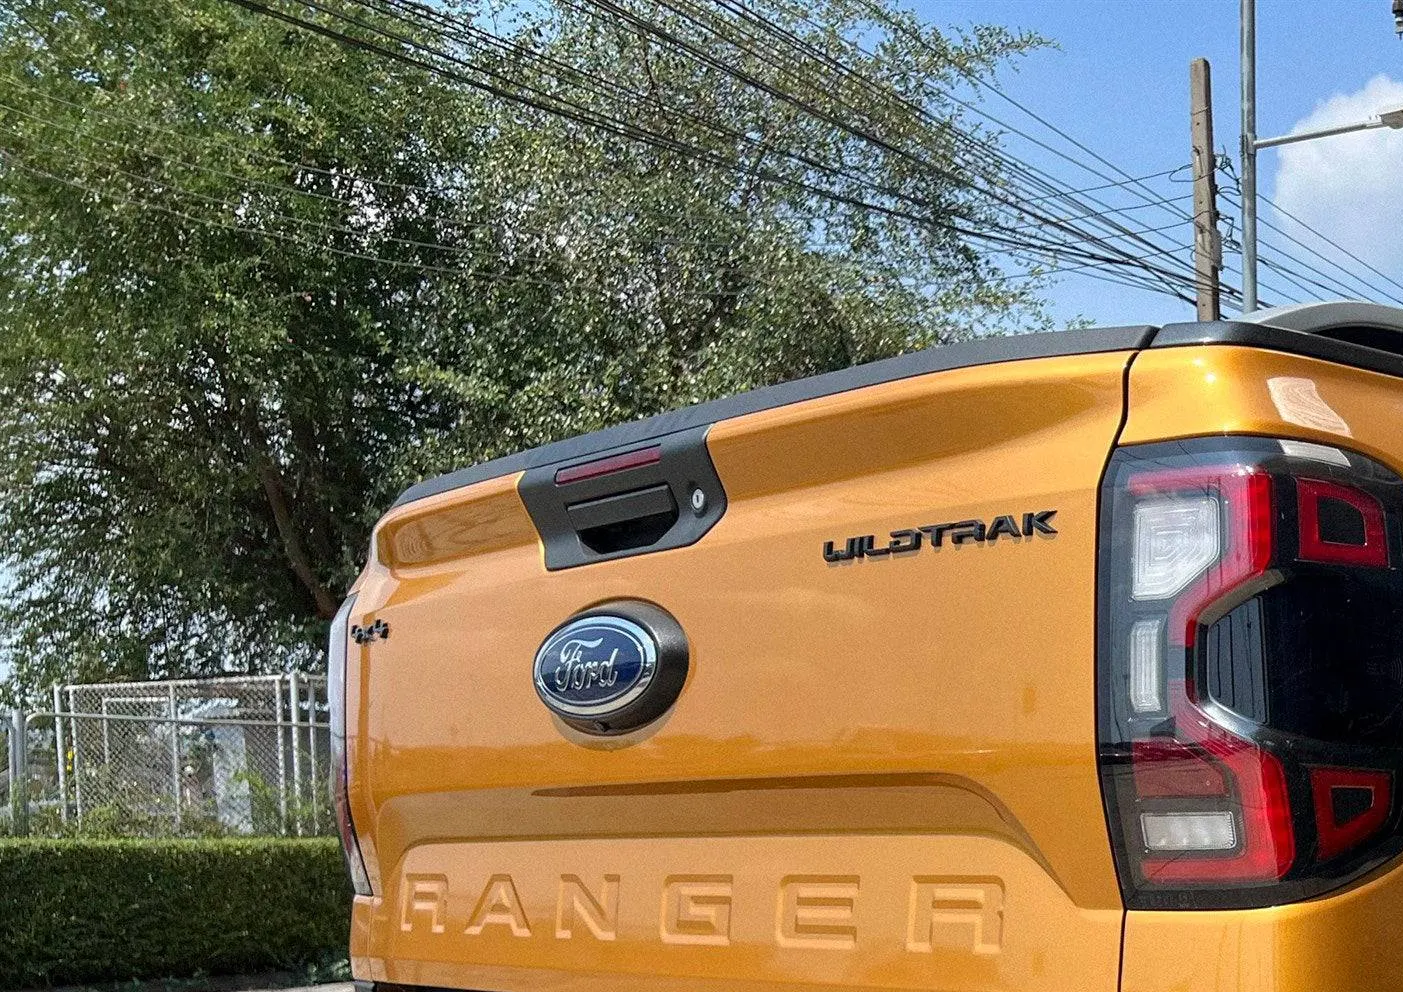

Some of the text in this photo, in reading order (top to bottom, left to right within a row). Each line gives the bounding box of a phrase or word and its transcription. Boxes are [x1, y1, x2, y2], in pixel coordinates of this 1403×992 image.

[823, 510, 1058, 562] WILDTRAK
[555, 637, 618, 692] Ford
[399, 872, 1005, 955] RANGER
